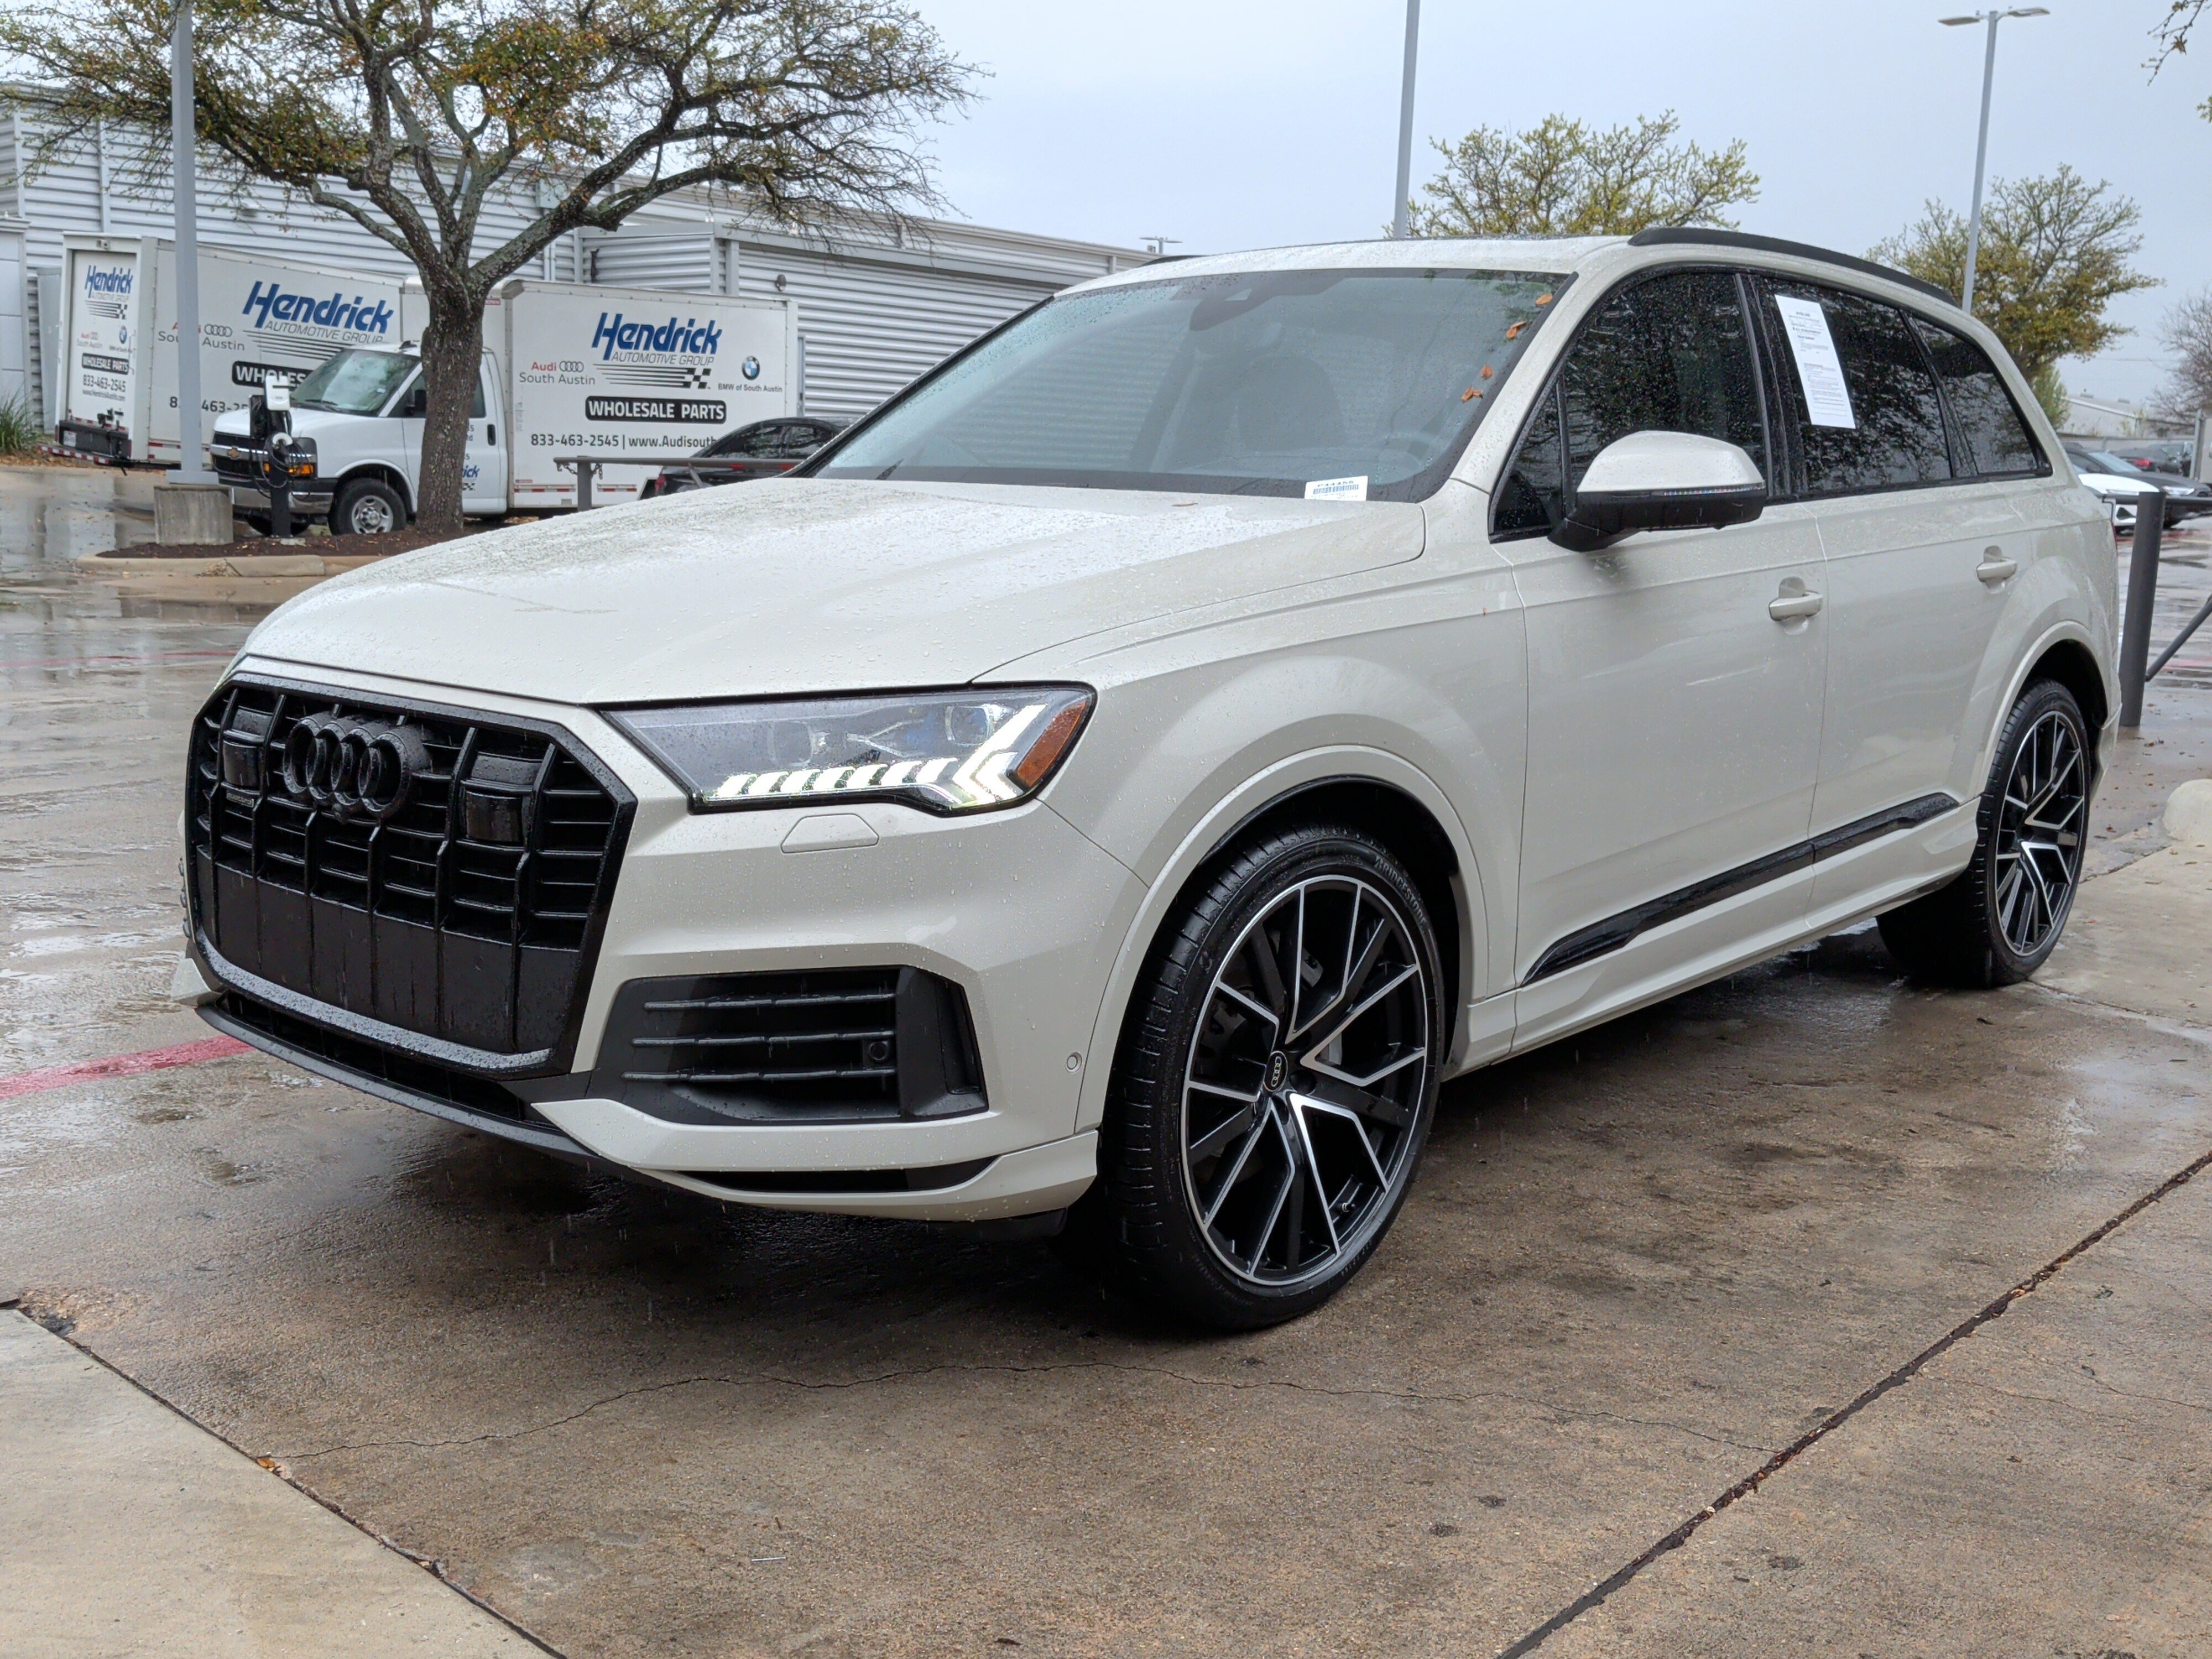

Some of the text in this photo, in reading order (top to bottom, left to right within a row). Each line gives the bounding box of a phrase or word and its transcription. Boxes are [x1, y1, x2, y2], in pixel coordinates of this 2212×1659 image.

[85, 265, 133, 298] Hendrick
[242, 281, 394, 334] Hendrick
[264, 321, 383, 343] AUTOMOTIVE GROUP
[591, 312, 723, 361] Hendrick
[202, 337, 245, 351] Austin
[531, 362, 557, 371] Audi
[612, 352, 714, 366] AUTOMOTIVE GROUP
[83, 374, 126, 393] 833-463-2545
[519, 372, 596, 385] South Austin
[743, 384, 762, 392] South
[588, 401, 725, 420] WHOLESALE PARTS
[531, 434, 619, 447] 833-463-2545
